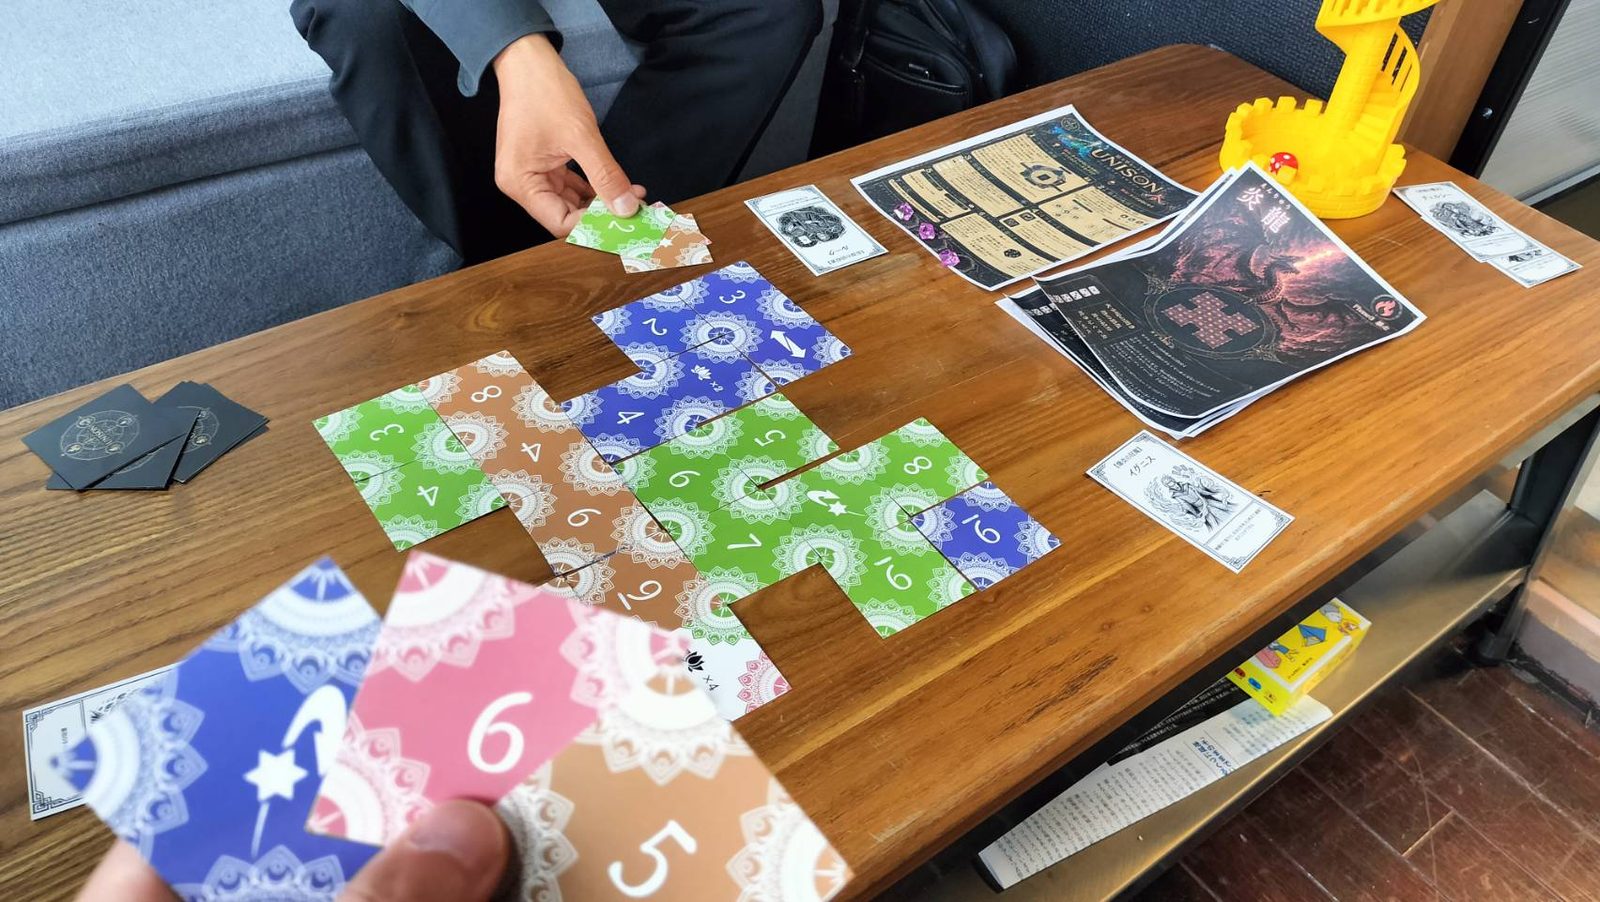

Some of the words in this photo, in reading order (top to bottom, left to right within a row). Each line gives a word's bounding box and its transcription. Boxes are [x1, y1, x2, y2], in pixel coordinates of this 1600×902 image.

[1091, 148, 1163, 193] UNISON
[1236, 187, 1291, 234] 炎龍
[608, 220, 635, 232] 2
[719, 290, 746, 304] 3
[642, 317, 668, 336] 2
[470, 384, 502, 403] 8
[616, 410, 645, 426] 4
[369, 423, 405, 442] 3
[754, 429, 786, 447] 5
[520, 441, 542, 463] 4
[903, 455, 933, 476] 8
[1128, 455, 1157, 477] イグニス
[416, 485, 439, 507] 4
[727, 533, 762, 550] 7
[465, 690, 534, 774] 6
[607, 819, 697, 899] 5
